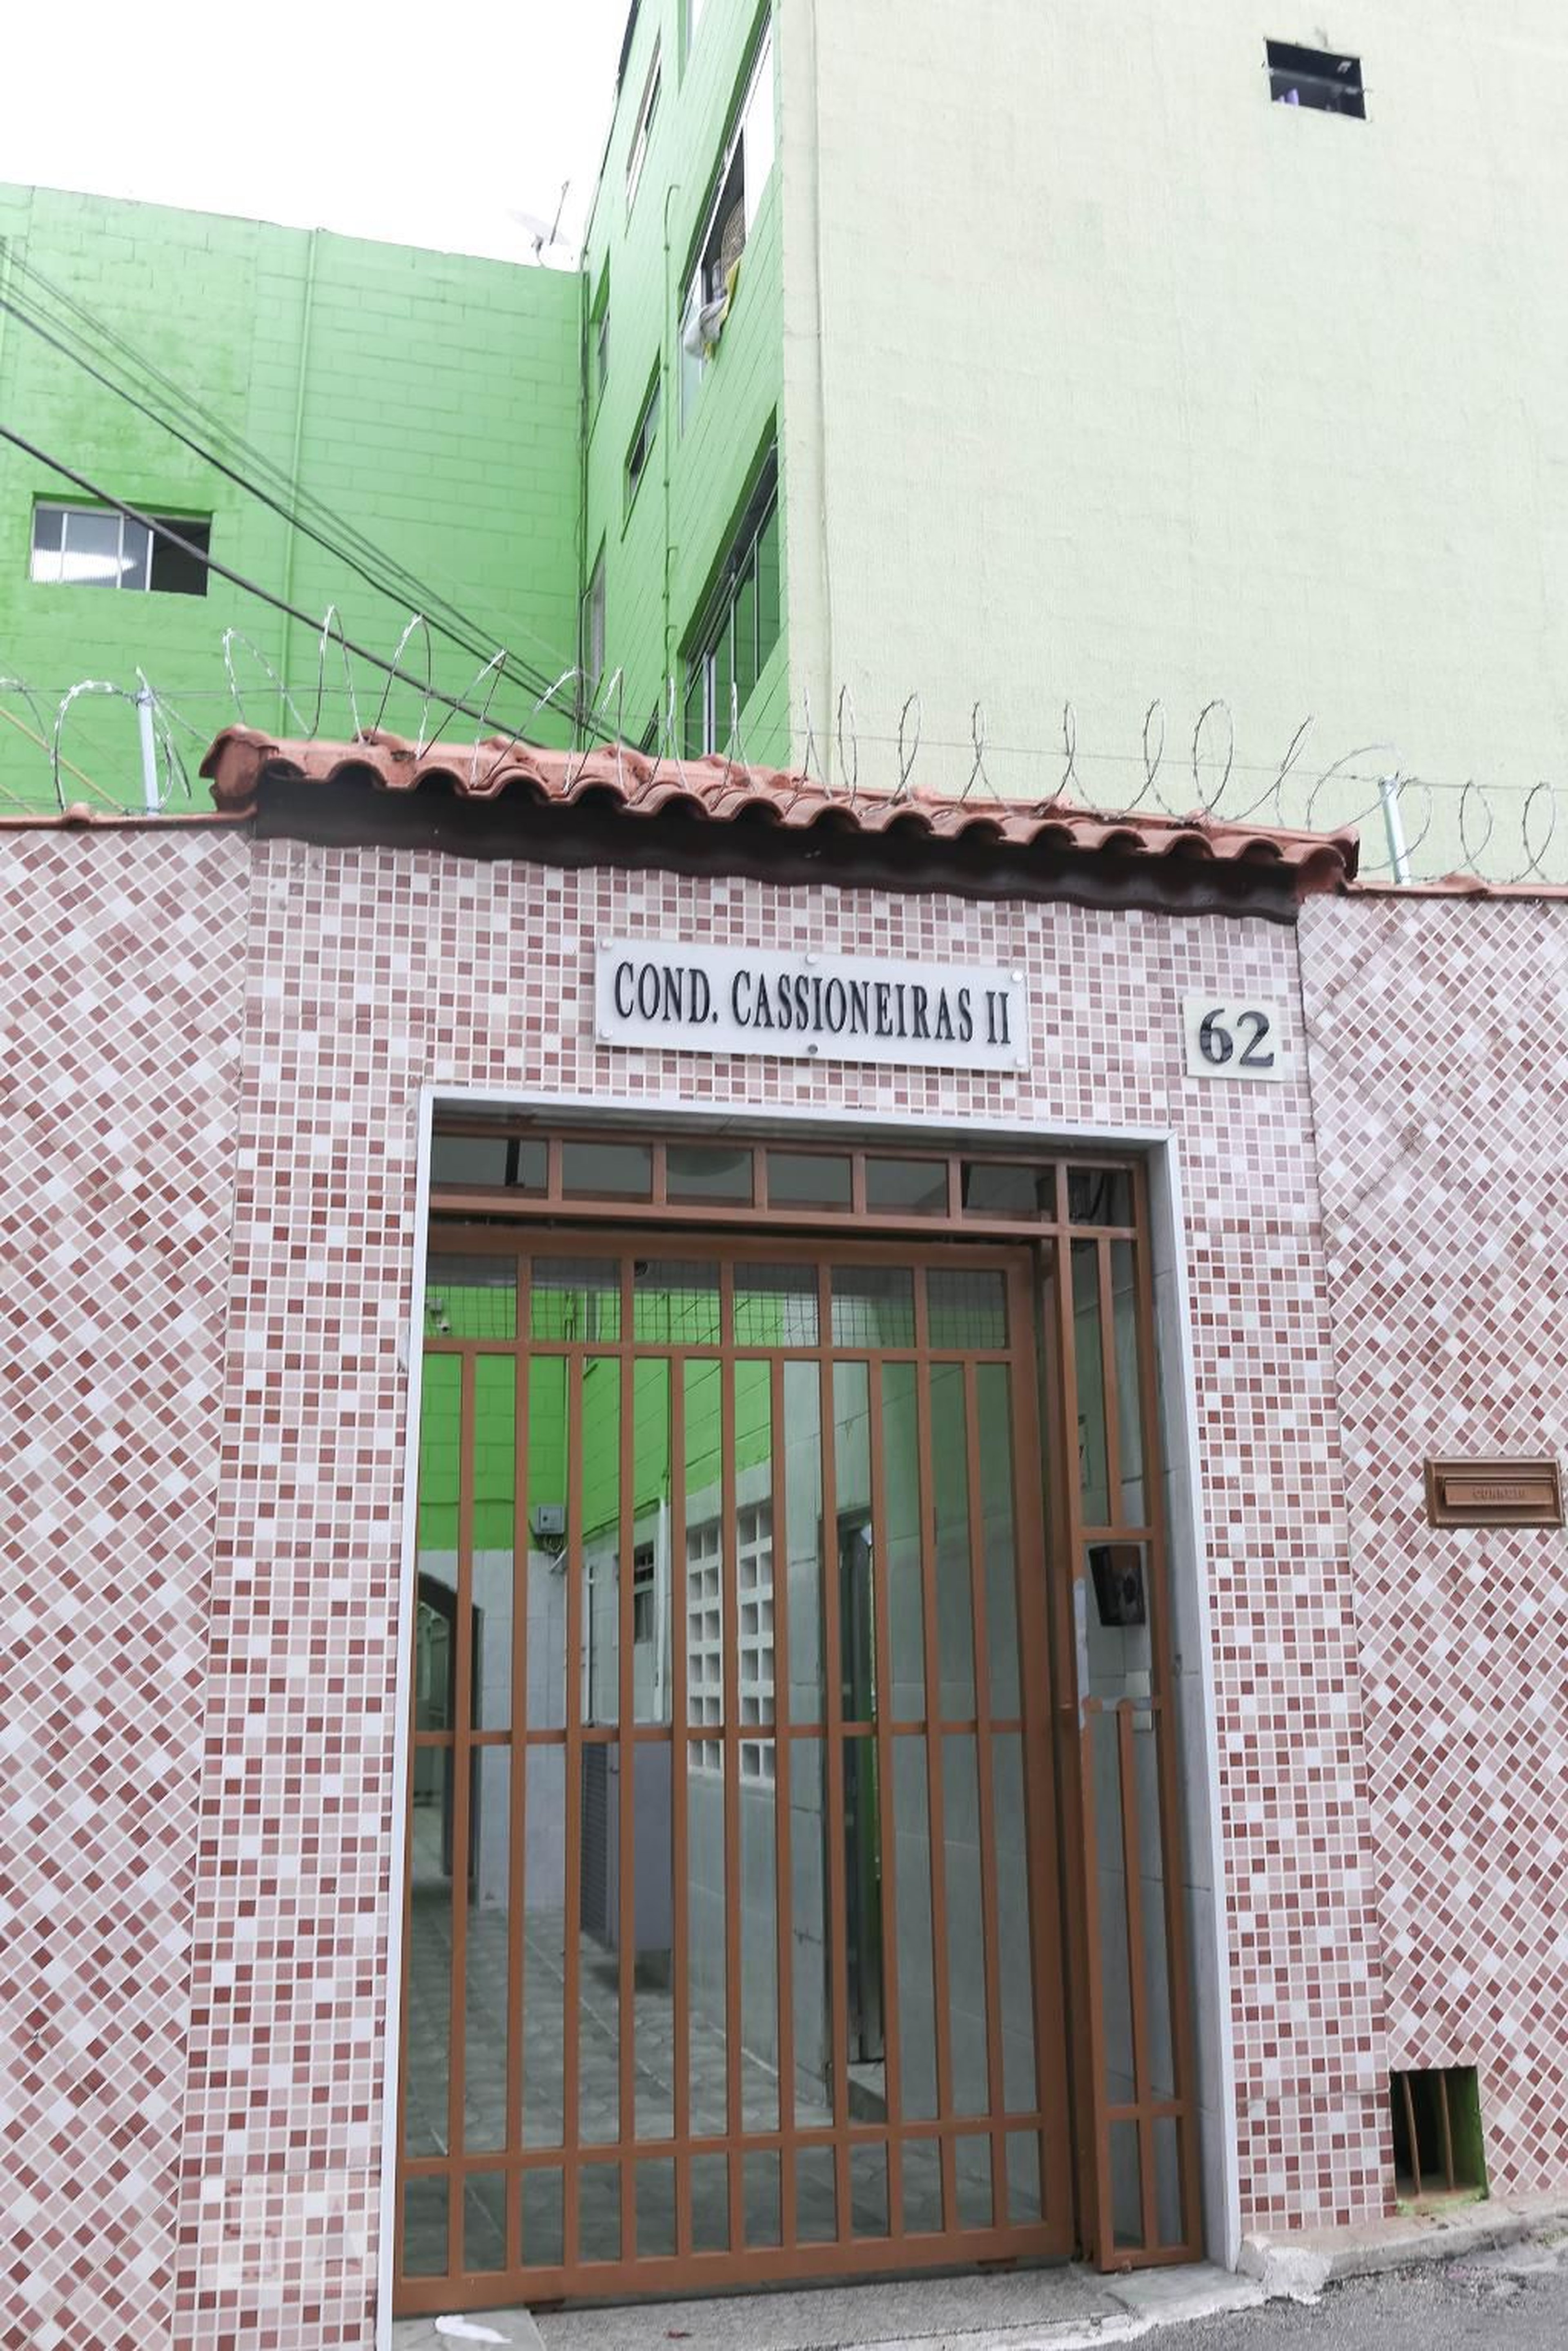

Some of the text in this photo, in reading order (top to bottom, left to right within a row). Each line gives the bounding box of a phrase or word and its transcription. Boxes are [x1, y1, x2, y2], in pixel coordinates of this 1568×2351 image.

[614, 961, 1012, 1045] COND. CASSIONEIRAS II
[1199, 1008, 1274, 1067] 62
